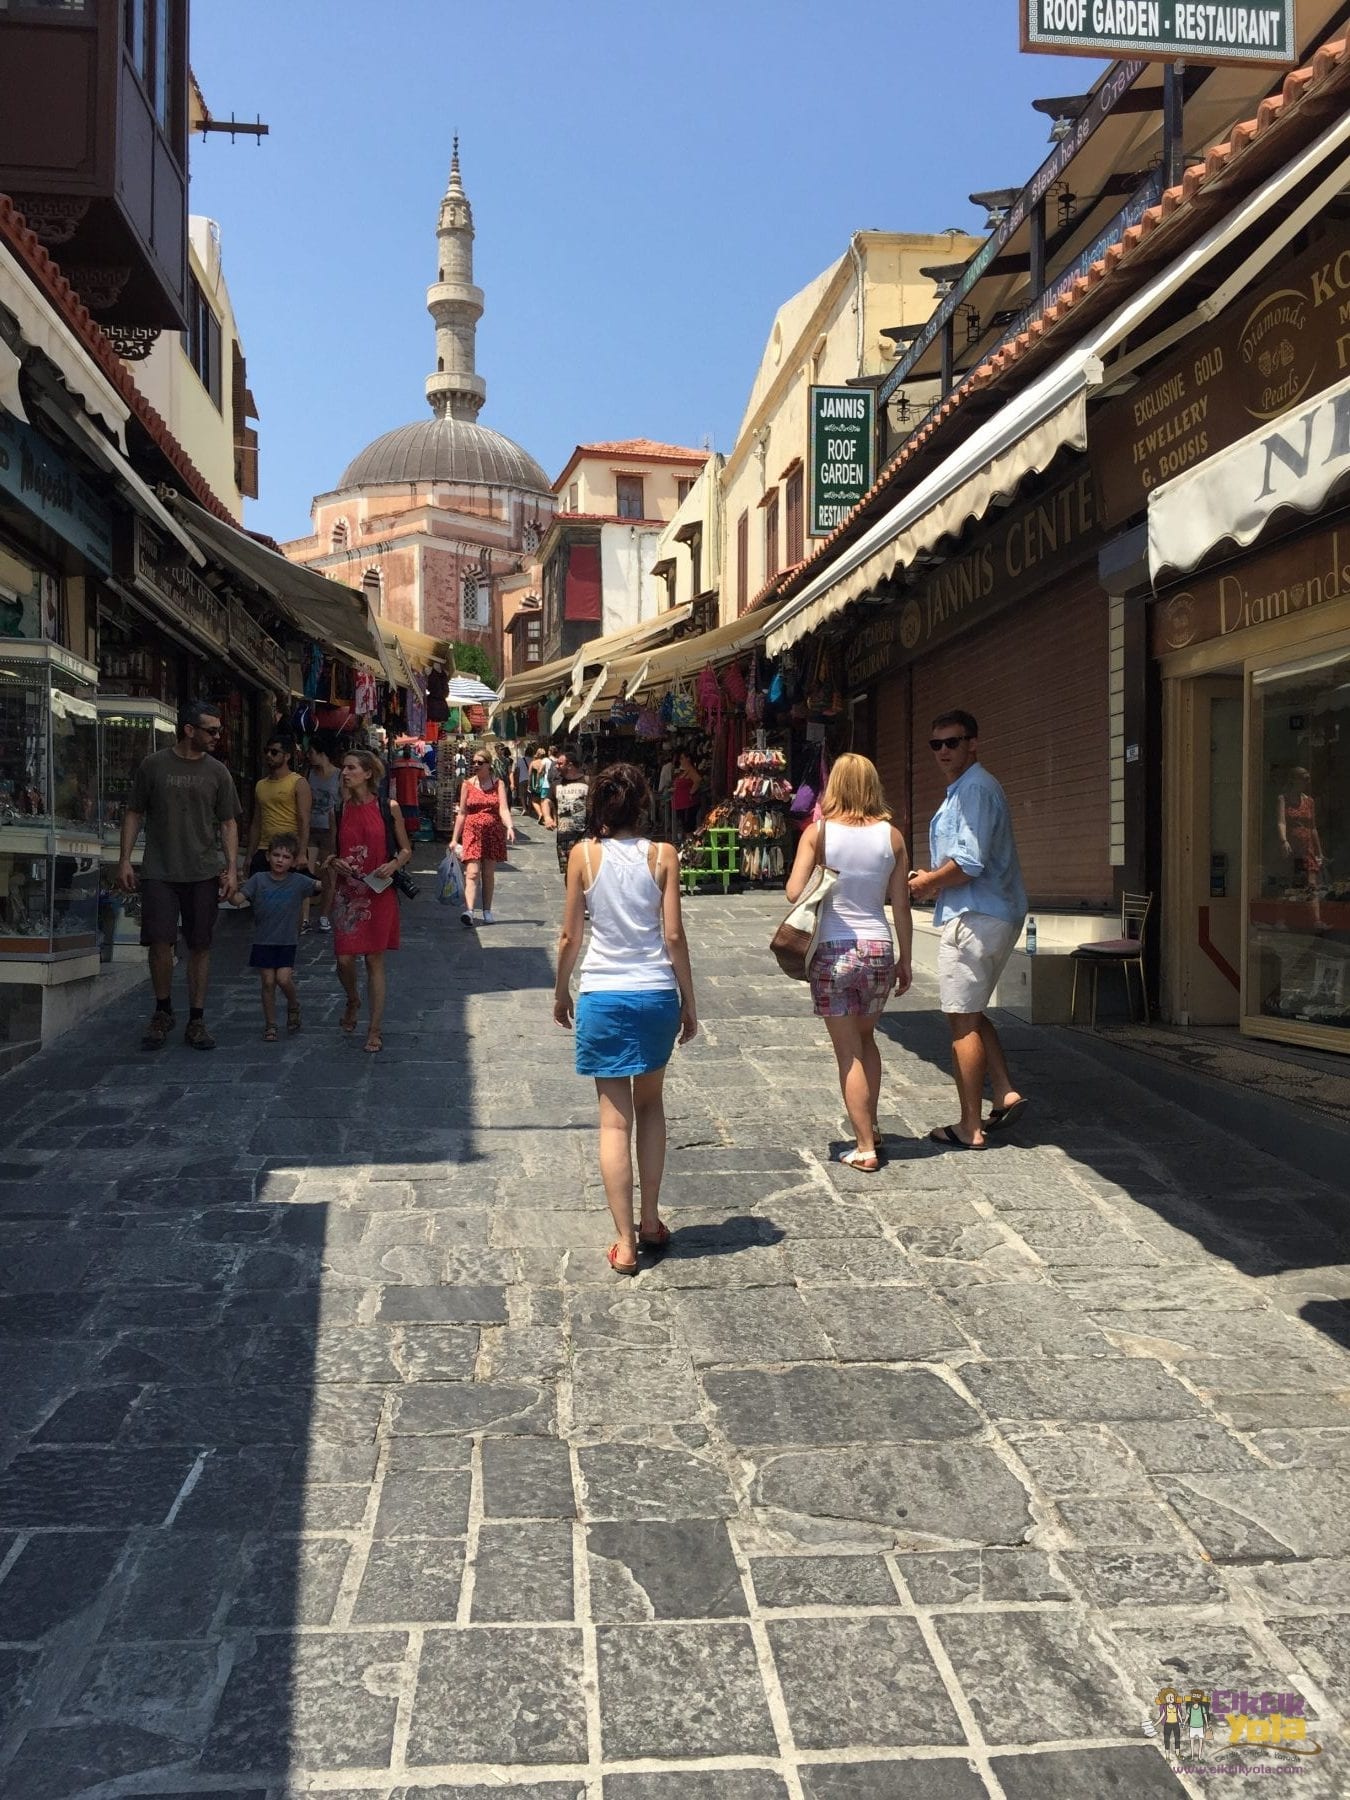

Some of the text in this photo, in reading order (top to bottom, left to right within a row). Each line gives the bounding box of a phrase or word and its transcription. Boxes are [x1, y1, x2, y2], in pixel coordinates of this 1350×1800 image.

[1043, 0, 1087, 31] ROOF
[1092, 0, 1160, 37] GARDEN
[1174, 4, 1281, 46] RESTAURANT
[1243, 304, 1306, 363] Diamonds
[820, 398, 865, 419] JANNIS
[1134, 346, 1223, 426] EXCLUSIVE GOLD
[1262, 368, 1299, 410] Pearls
[827, 439, 856, 460] ROOF
[1133, 394, 1208, 465] JEWELLERY
[821, 463, 863, 485] GARDEN
[1142, 431, 1208, 488] G. BOUSIS
[926, 541, 994, 640] JANNIS
